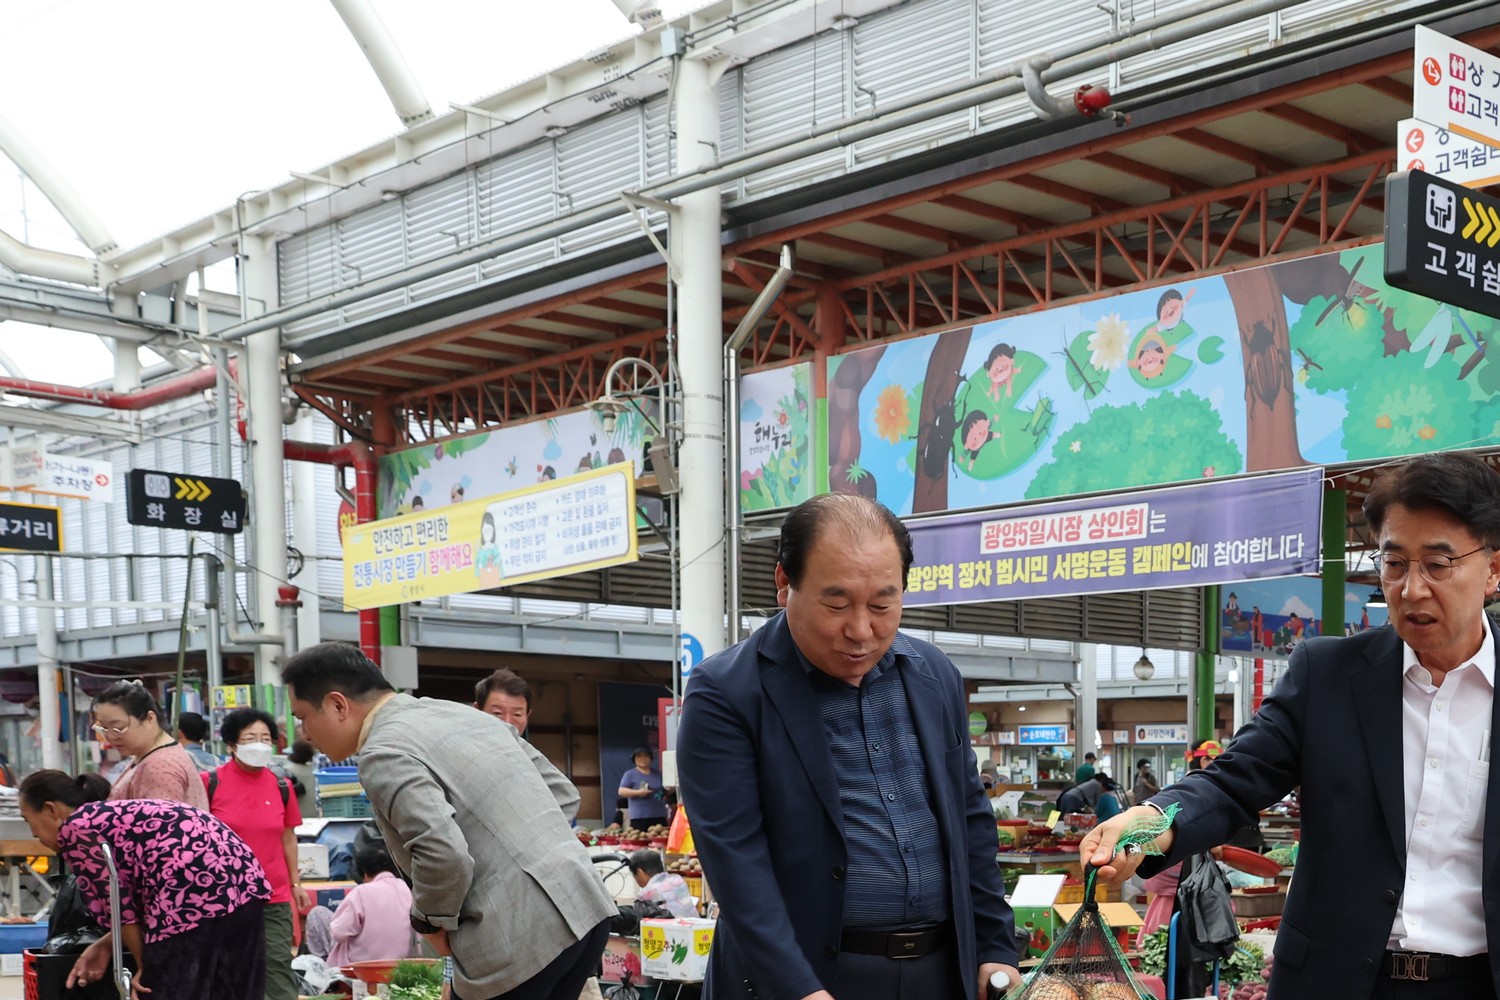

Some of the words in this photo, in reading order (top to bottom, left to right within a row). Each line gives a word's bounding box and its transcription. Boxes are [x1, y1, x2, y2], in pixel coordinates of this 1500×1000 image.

[53, 475, 93, 491] 주차장
[146, 502, 238, 529] 화장실
[609, 516, 621, 530] 금지
[373, 525, 414, 554] 안전하고
[416, 516, 448, 546] 편리한
[984, 515, 1083, 550] 광양5일시장
[353, 558, 393, 588] 전통시장
[395, 551, 426, 581] 만들기
[429, 543, 473, 575] 함께해요
[958, 560, 992, 589] 정차
[996, 555, 1048, 586] 범시민
[1053, 547, 1126, 580] 서명운동
[1132, 542, 1209, 575] 캠페인에
[1213, 533, 1304, 567] 참여합니다
[644, 938, 670, 952] 청양고추
